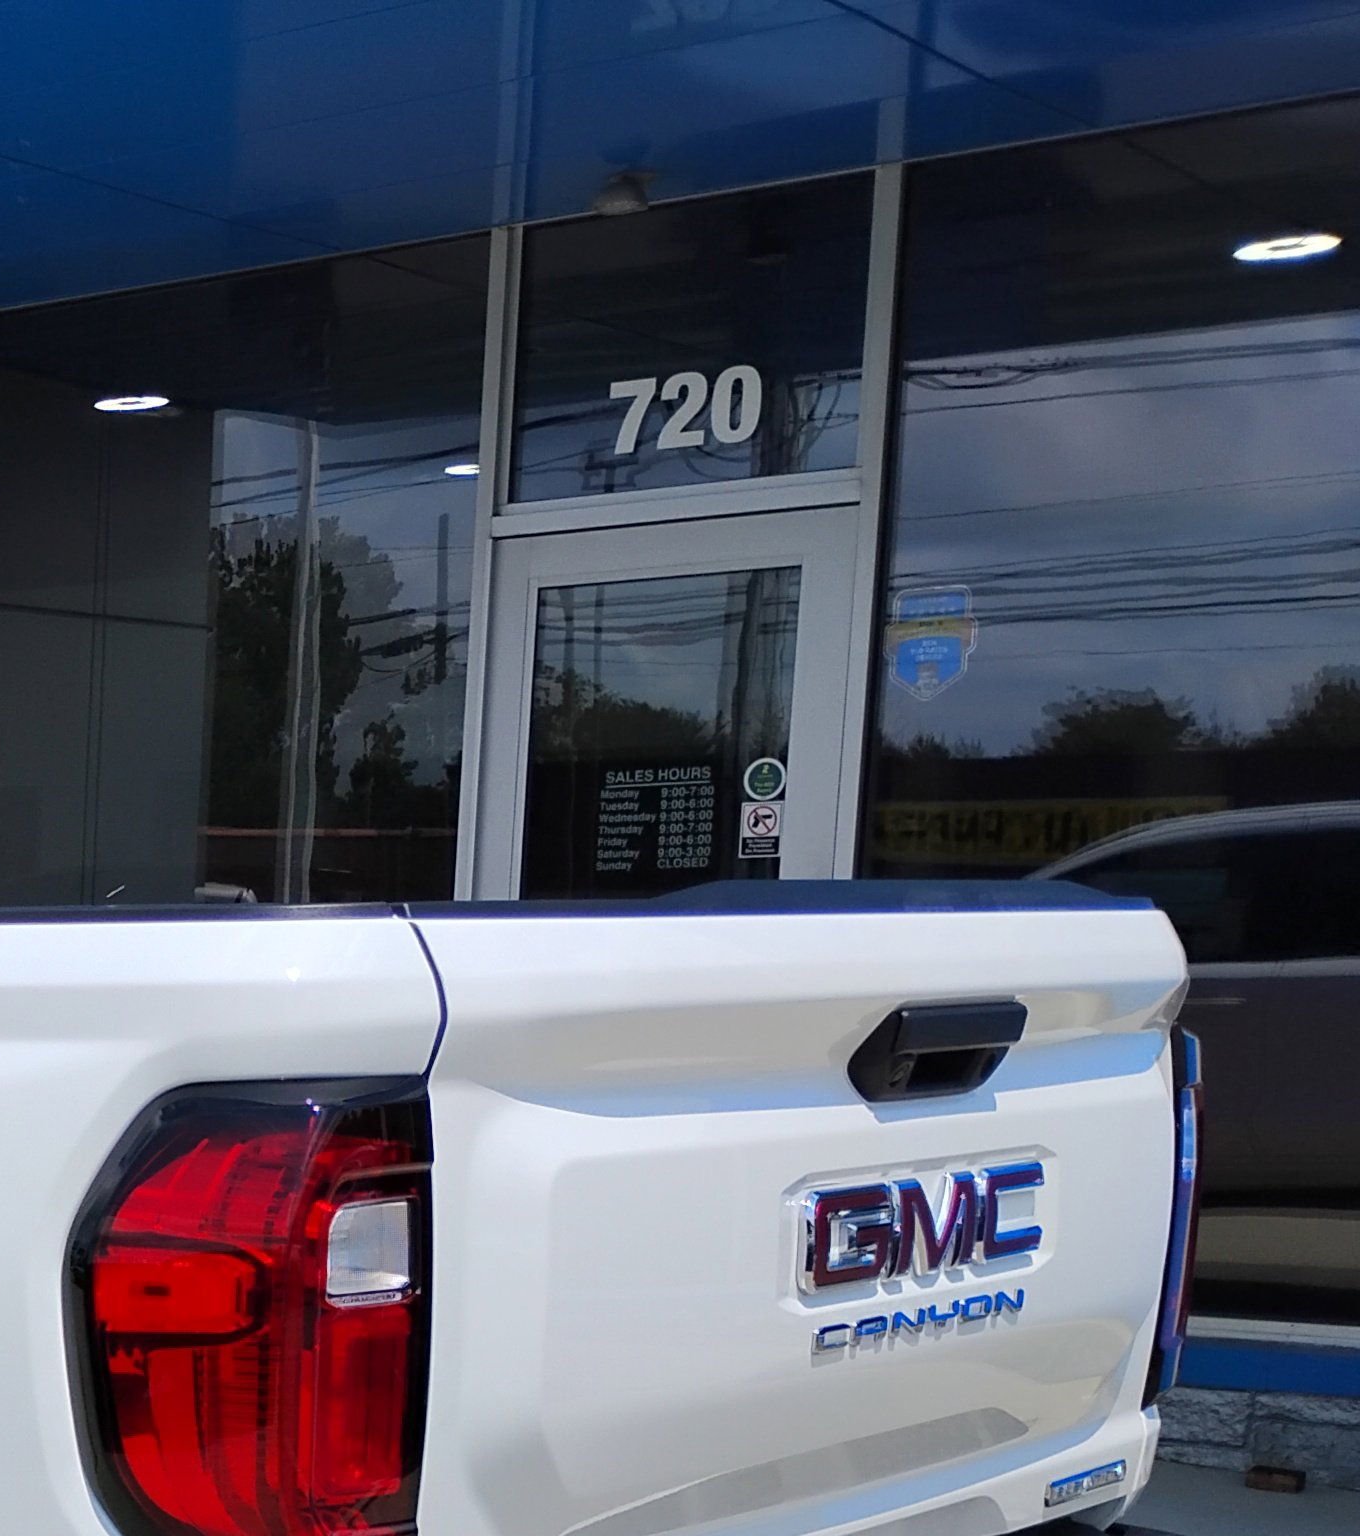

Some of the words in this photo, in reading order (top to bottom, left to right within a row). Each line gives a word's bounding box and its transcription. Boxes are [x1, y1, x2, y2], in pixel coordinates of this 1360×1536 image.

[609, 365, 762, 455] 720
[605, 769, 654, 783] SALES
[658, 766, 711, 780] HOURS
[600, 789, 639, 799] Monday
[600, 801, 639, 811] Tuesday
[599, 813, 656, 823] Wednesday
[598, 825, 643, 835] Thursday
[597, 838, 628, 847] Friday
[597, 849, 640, 859] Saturday
[596, 861, 632, 871] Sunday
[657, 857, 708, 868] CLOSED
[804, 1161, 1044, 1291] GMC
[811, 1288, 1024, 1354] CANYON
